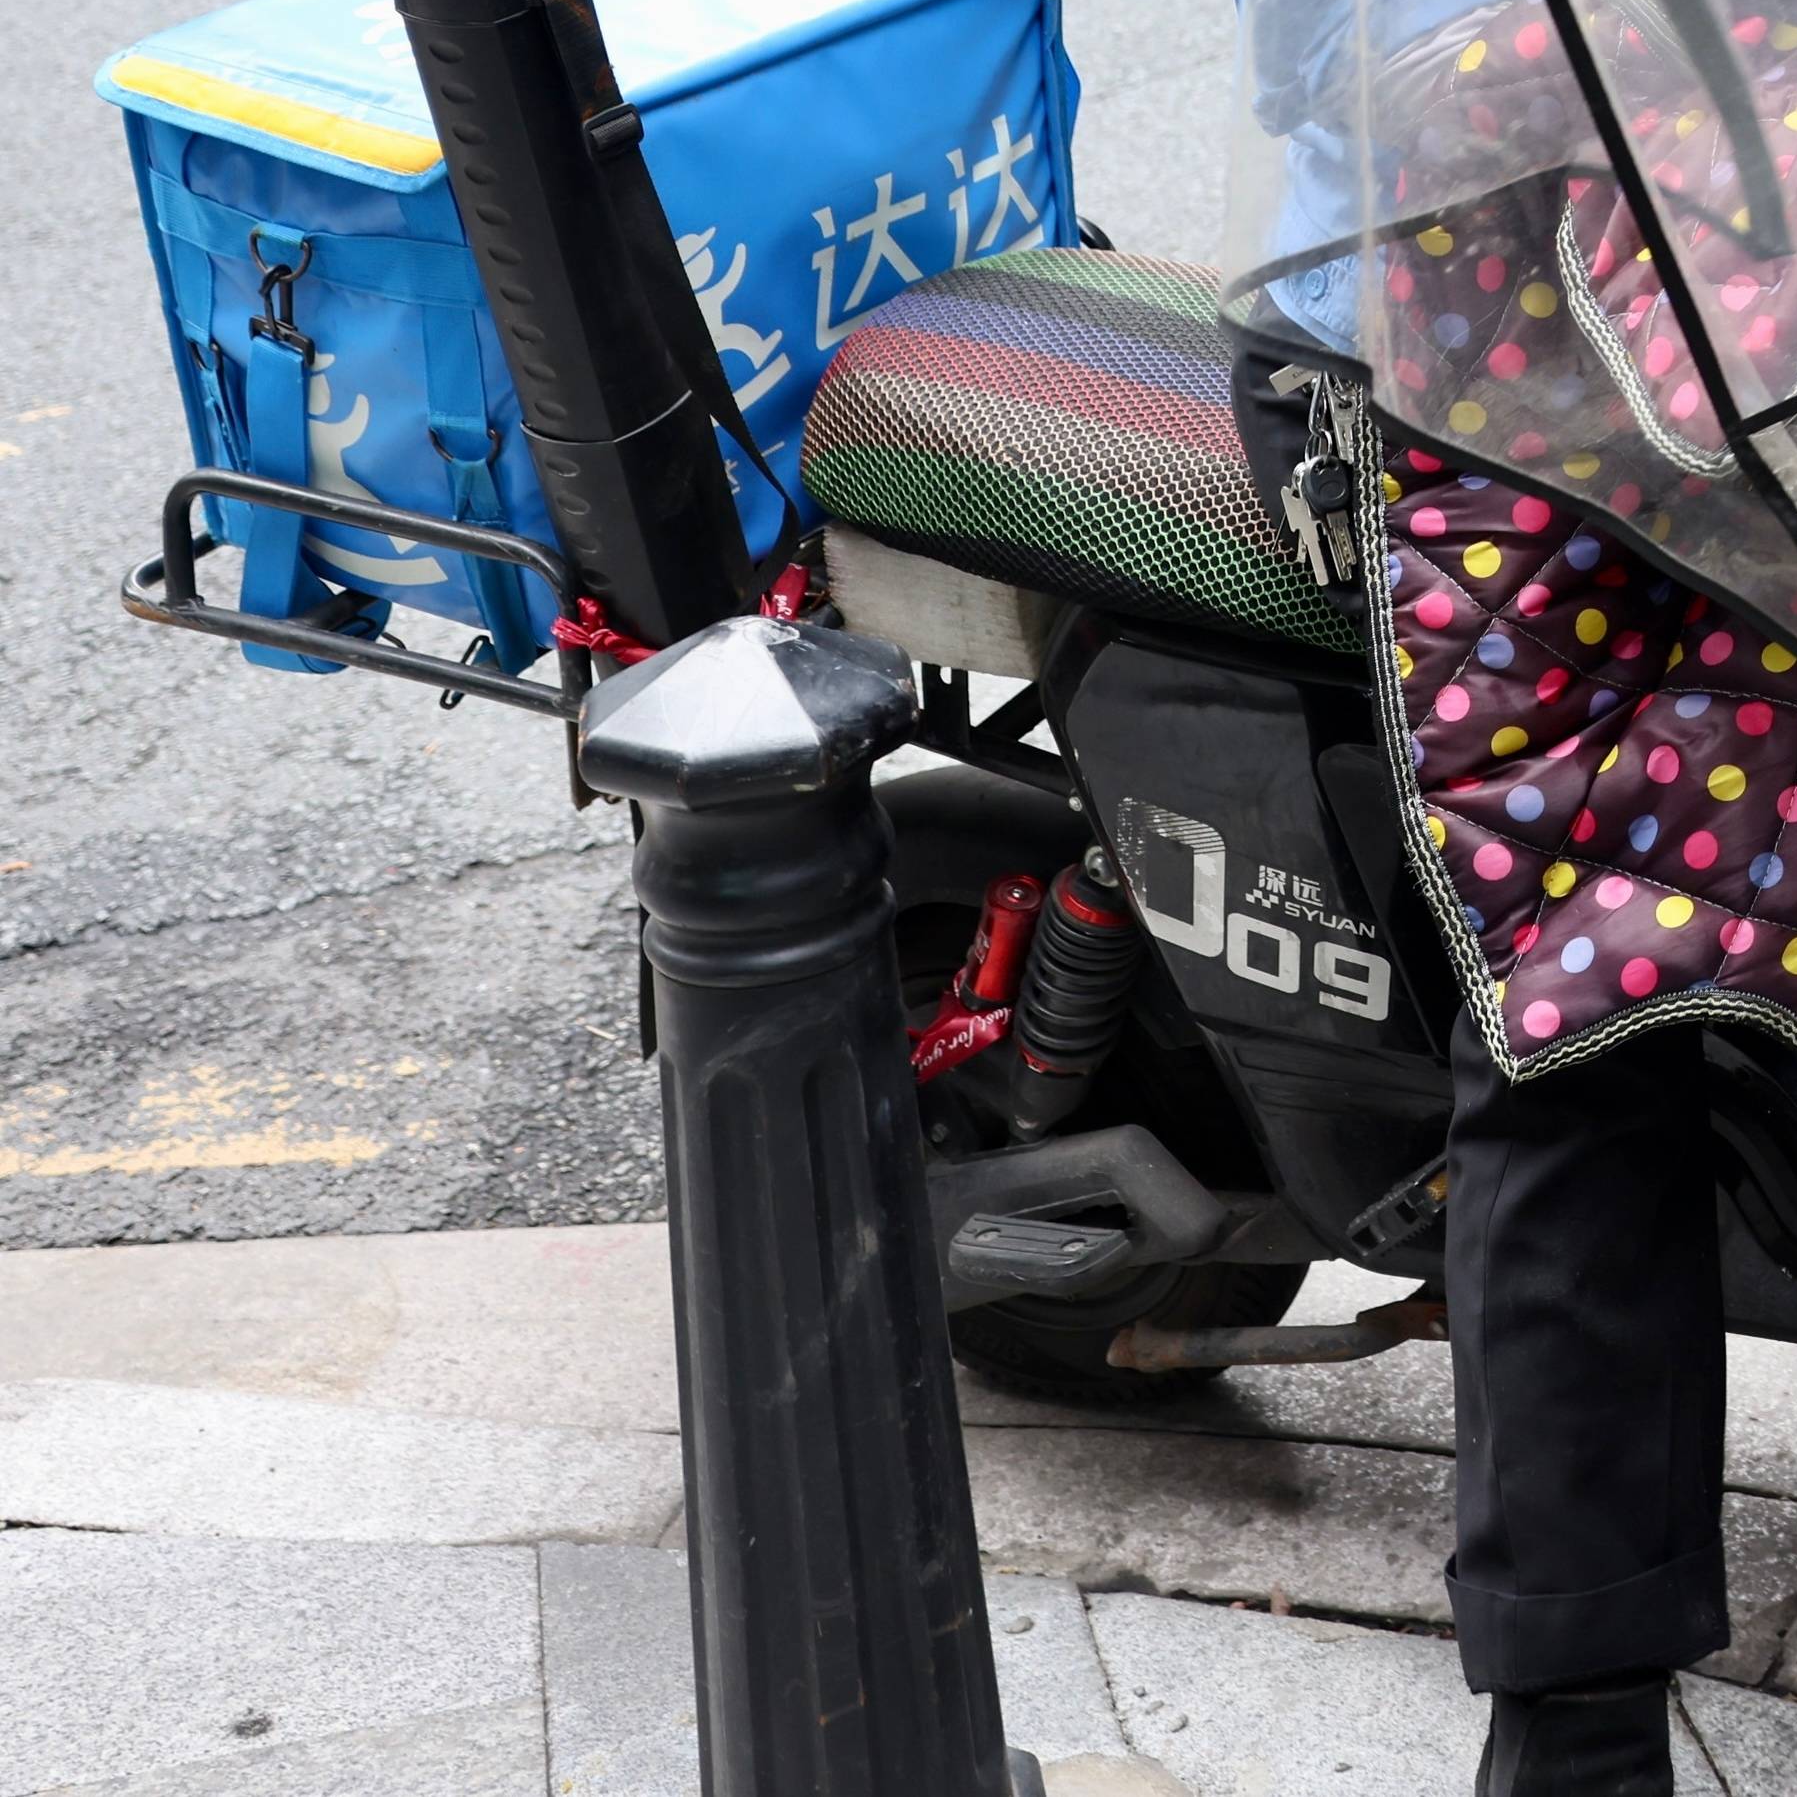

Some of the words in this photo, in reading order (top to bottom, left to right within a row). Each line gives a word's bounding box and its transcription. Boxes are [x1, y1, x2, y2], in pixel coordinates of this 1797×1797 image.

[810, 113, 1044, 351] 达达
[1258, 865, 1323, 907] 深远
[1284, 901, 1376, 939] SYUAN
